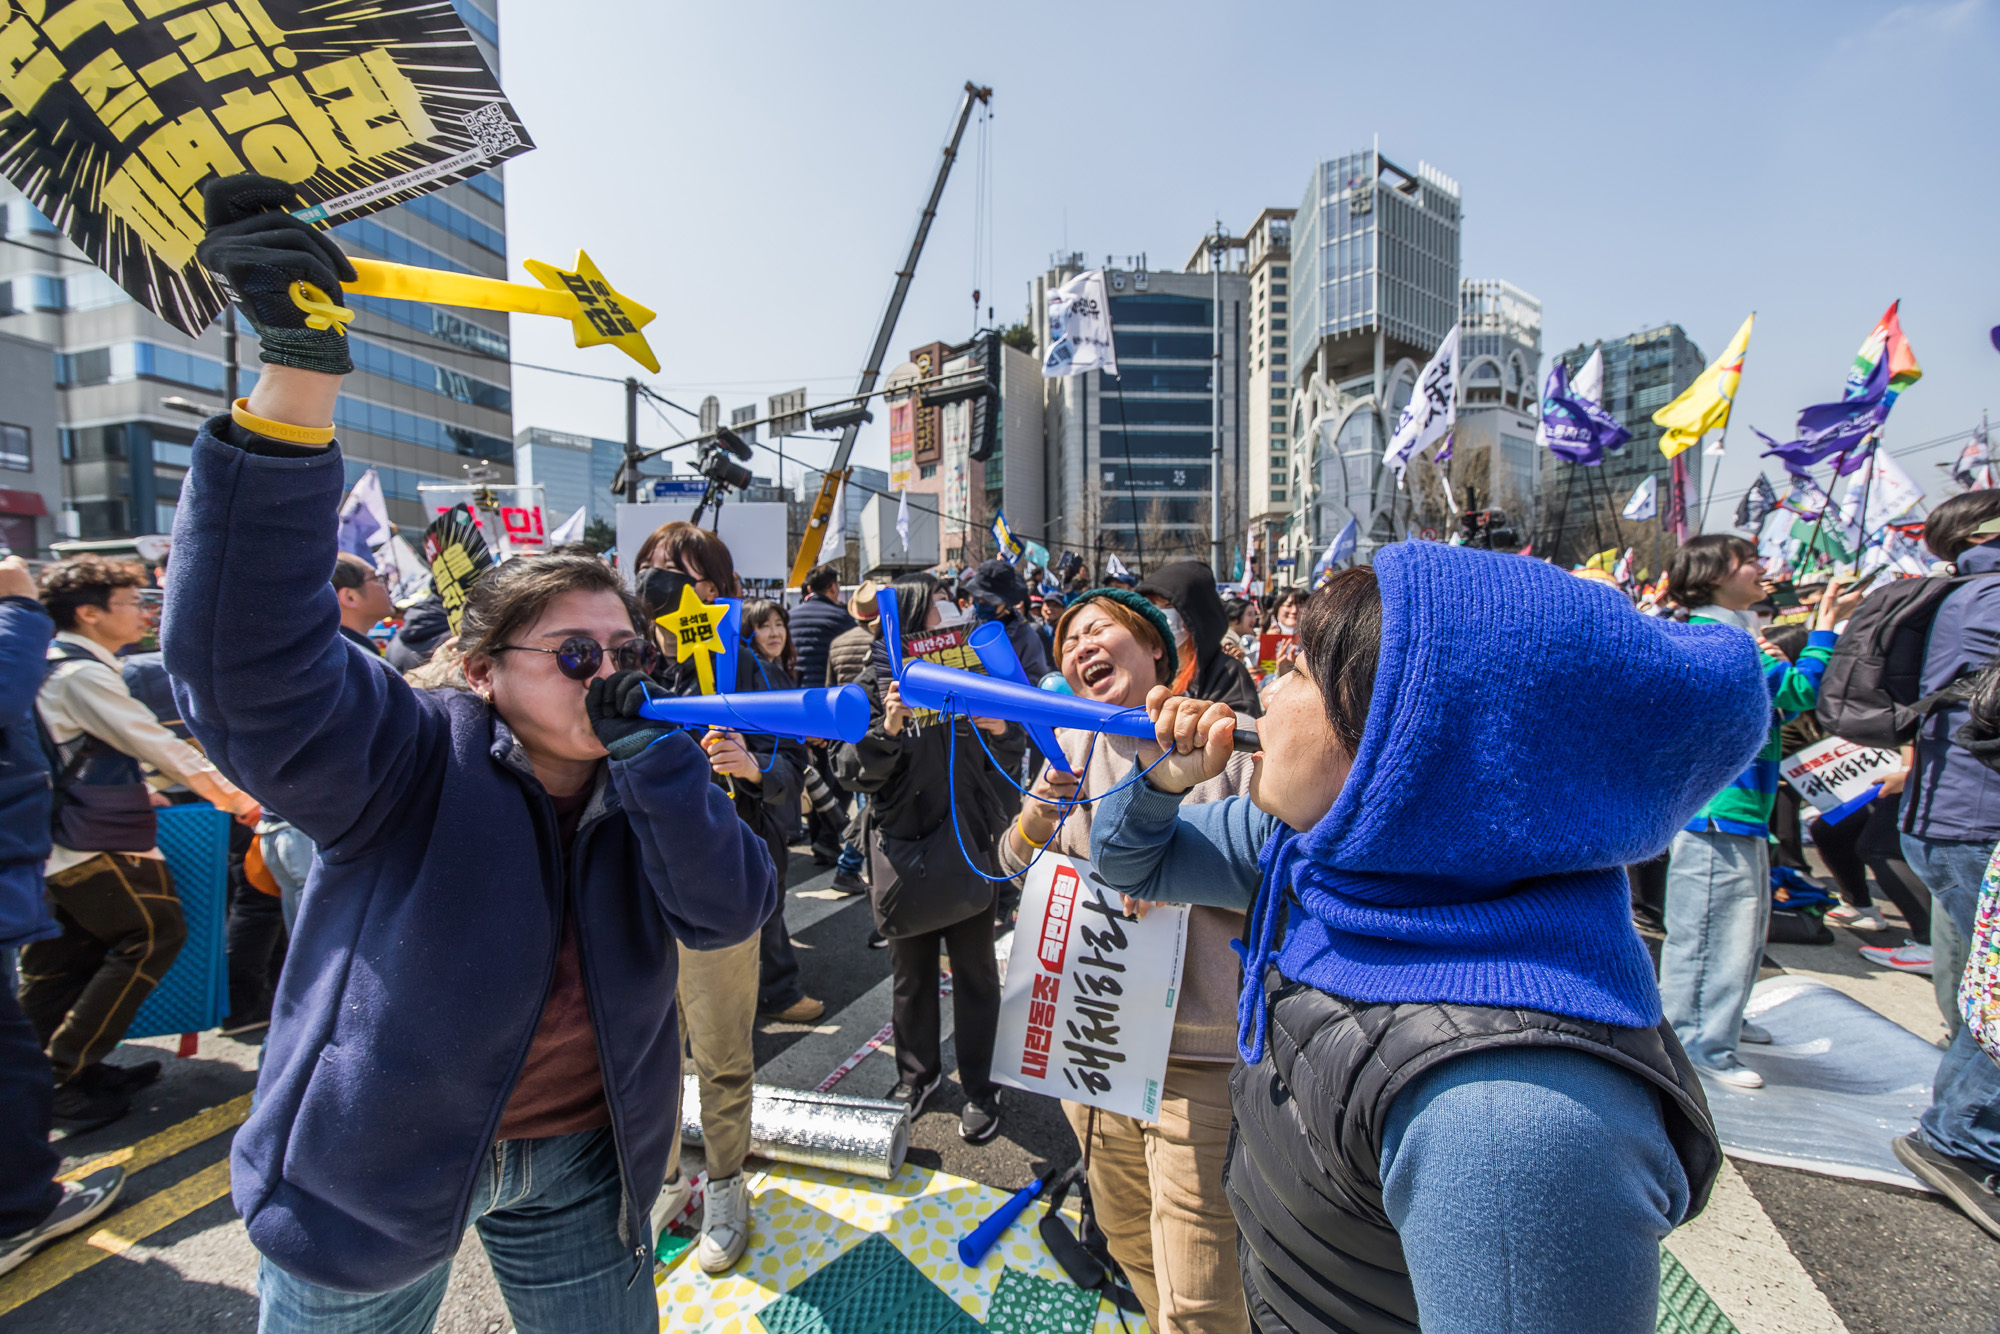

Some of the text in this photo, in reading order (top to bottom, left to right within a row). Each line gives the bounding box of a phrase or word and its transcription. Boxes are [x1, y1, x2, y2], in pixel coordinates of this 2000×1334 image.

[103, 47, 440, 271] 파면하라
[556, 271, 625, 336] 파면
[589, 279, 638, 333] 윤석열
[257, 422, 316, 440] 20140416
[679, 623, 714, 645] 파면
[680, 612, 709, 627] 윤석열
[1787, 752, 1836, 779] 내란동조
[1041, 873, 1077, 964] 국민의힘
[1020, 973, 1060, 1080] 내란동조
